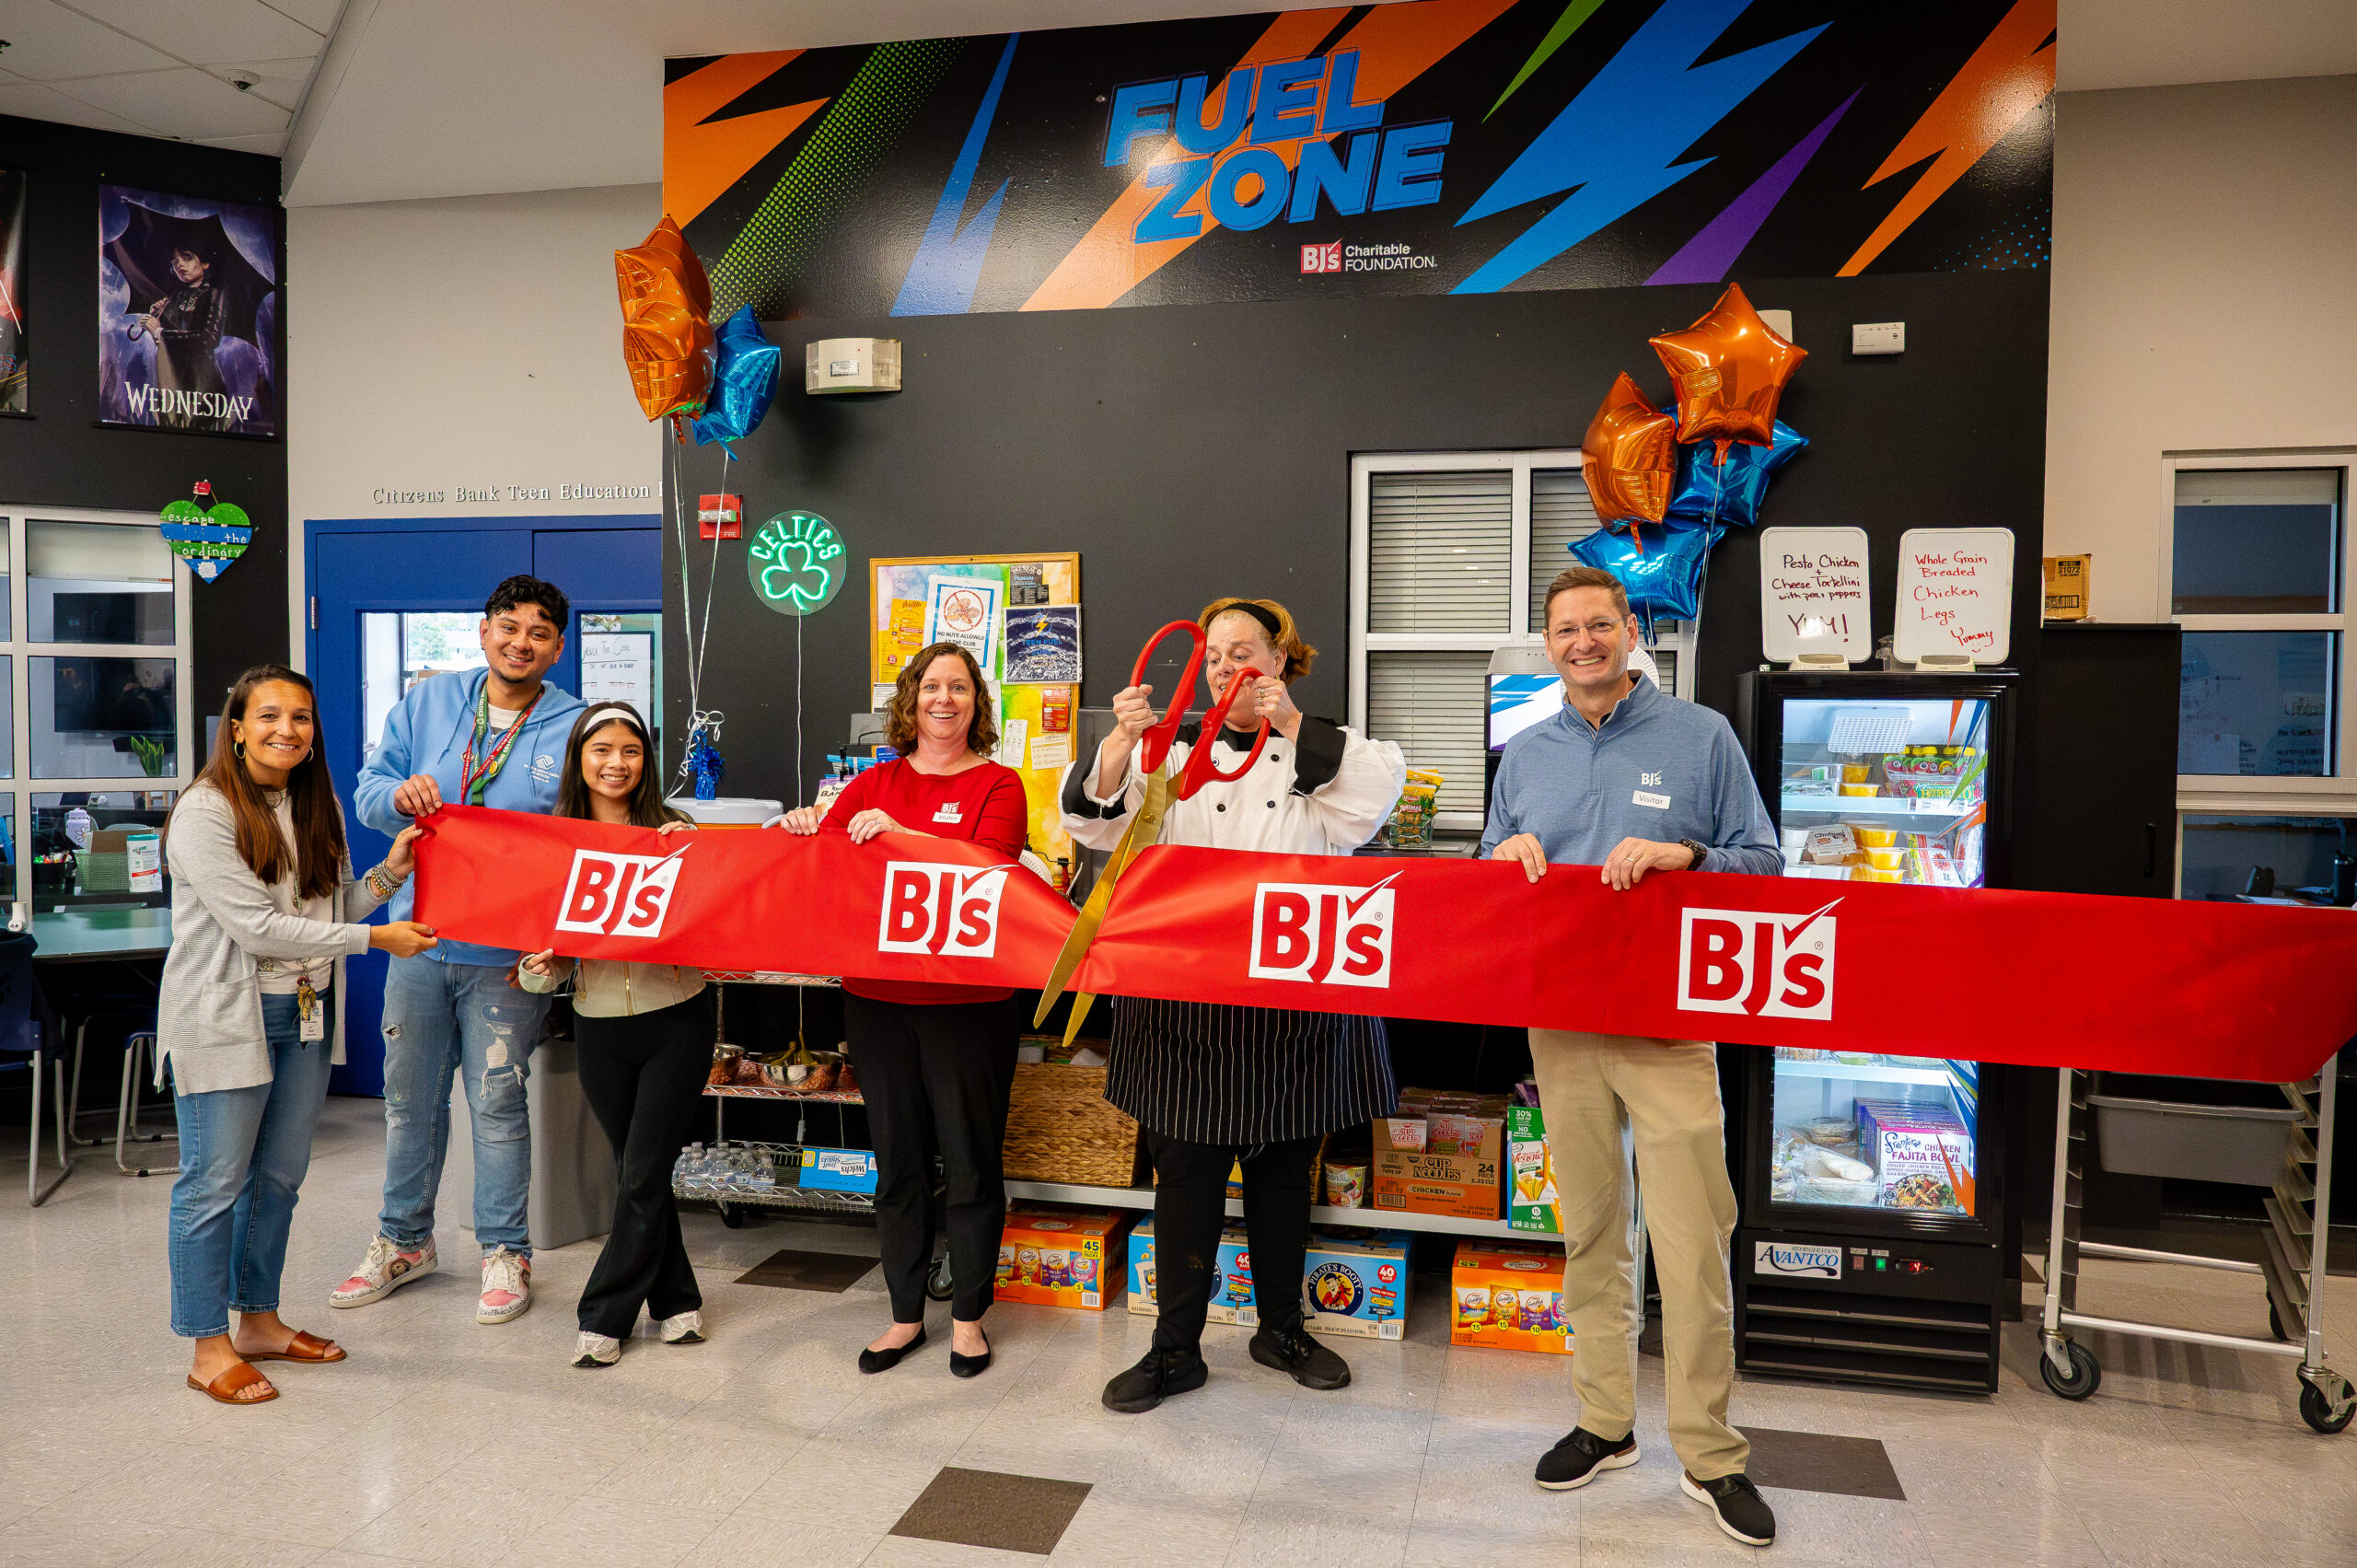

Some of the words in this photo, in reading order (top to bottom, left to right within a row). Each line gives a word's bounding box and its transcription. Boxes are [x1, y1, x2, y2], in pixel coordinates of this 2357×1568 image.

[1101, 48, 1385, 168] FUEL
[1132, 118, 1453, 245] ZONE
[1345, 243, 1411, 257] Charitable
[124, 380, 253, 424] WEDNESDAY
[373, 488, 445, 504] Citizens
[455, 485, 500, 502] Bank
[507, 484, 550, 500] Teen
[559, 482, 650, 500] Education
[168, 514, 215, 523] escape
[224, 533, 247, 544] the
[751, 515, 842, 561] CELTICS
[182, 545, 242, 559] ordinary
[1915, 554, 1947, 564] Whole
[1953, 551, 1988, 564] Grain
[1782, 554, 1813, 569] Pesto
[1818, 554, 1860, 569] Chicken
[1919, 567, 1976, 578] Breaded
[1771, 578, 1812, 589] Cheese
[1810, 575, 1861, 587] Tortellini
[1779, 592, 1801, 600] with
[1829, 591, 1862, 601] peppers
[1913, 586, 1979, 601] Chicken
[1921, 607, 1956, 626] Legs
[1950, 626, 1994, 647] Yummy
[1639, 795, 1664, 805] Visitor
[1924, 1144, 1961, 1153] CHIKEN
[1423, 1157, 1452, 1169] CUP
[1892, 1152, 1927, 1161] FAJITA
[1413, 1166, 1461, 1181] NOODLES
[1478, 1164, 1494, 1173] 24
[1411, 1186, 1446, 1195] CHICKEN
[1084, 1240, 1099, 1251] 45
[1758, 1245, 1839, 1267] AVANTCO
[1309, 1263, 1338, 1285] PIRATE'S
[1340, 1265, 1363, 1289] BOOTY
[1379, 1267, 1395, 1277] 40
